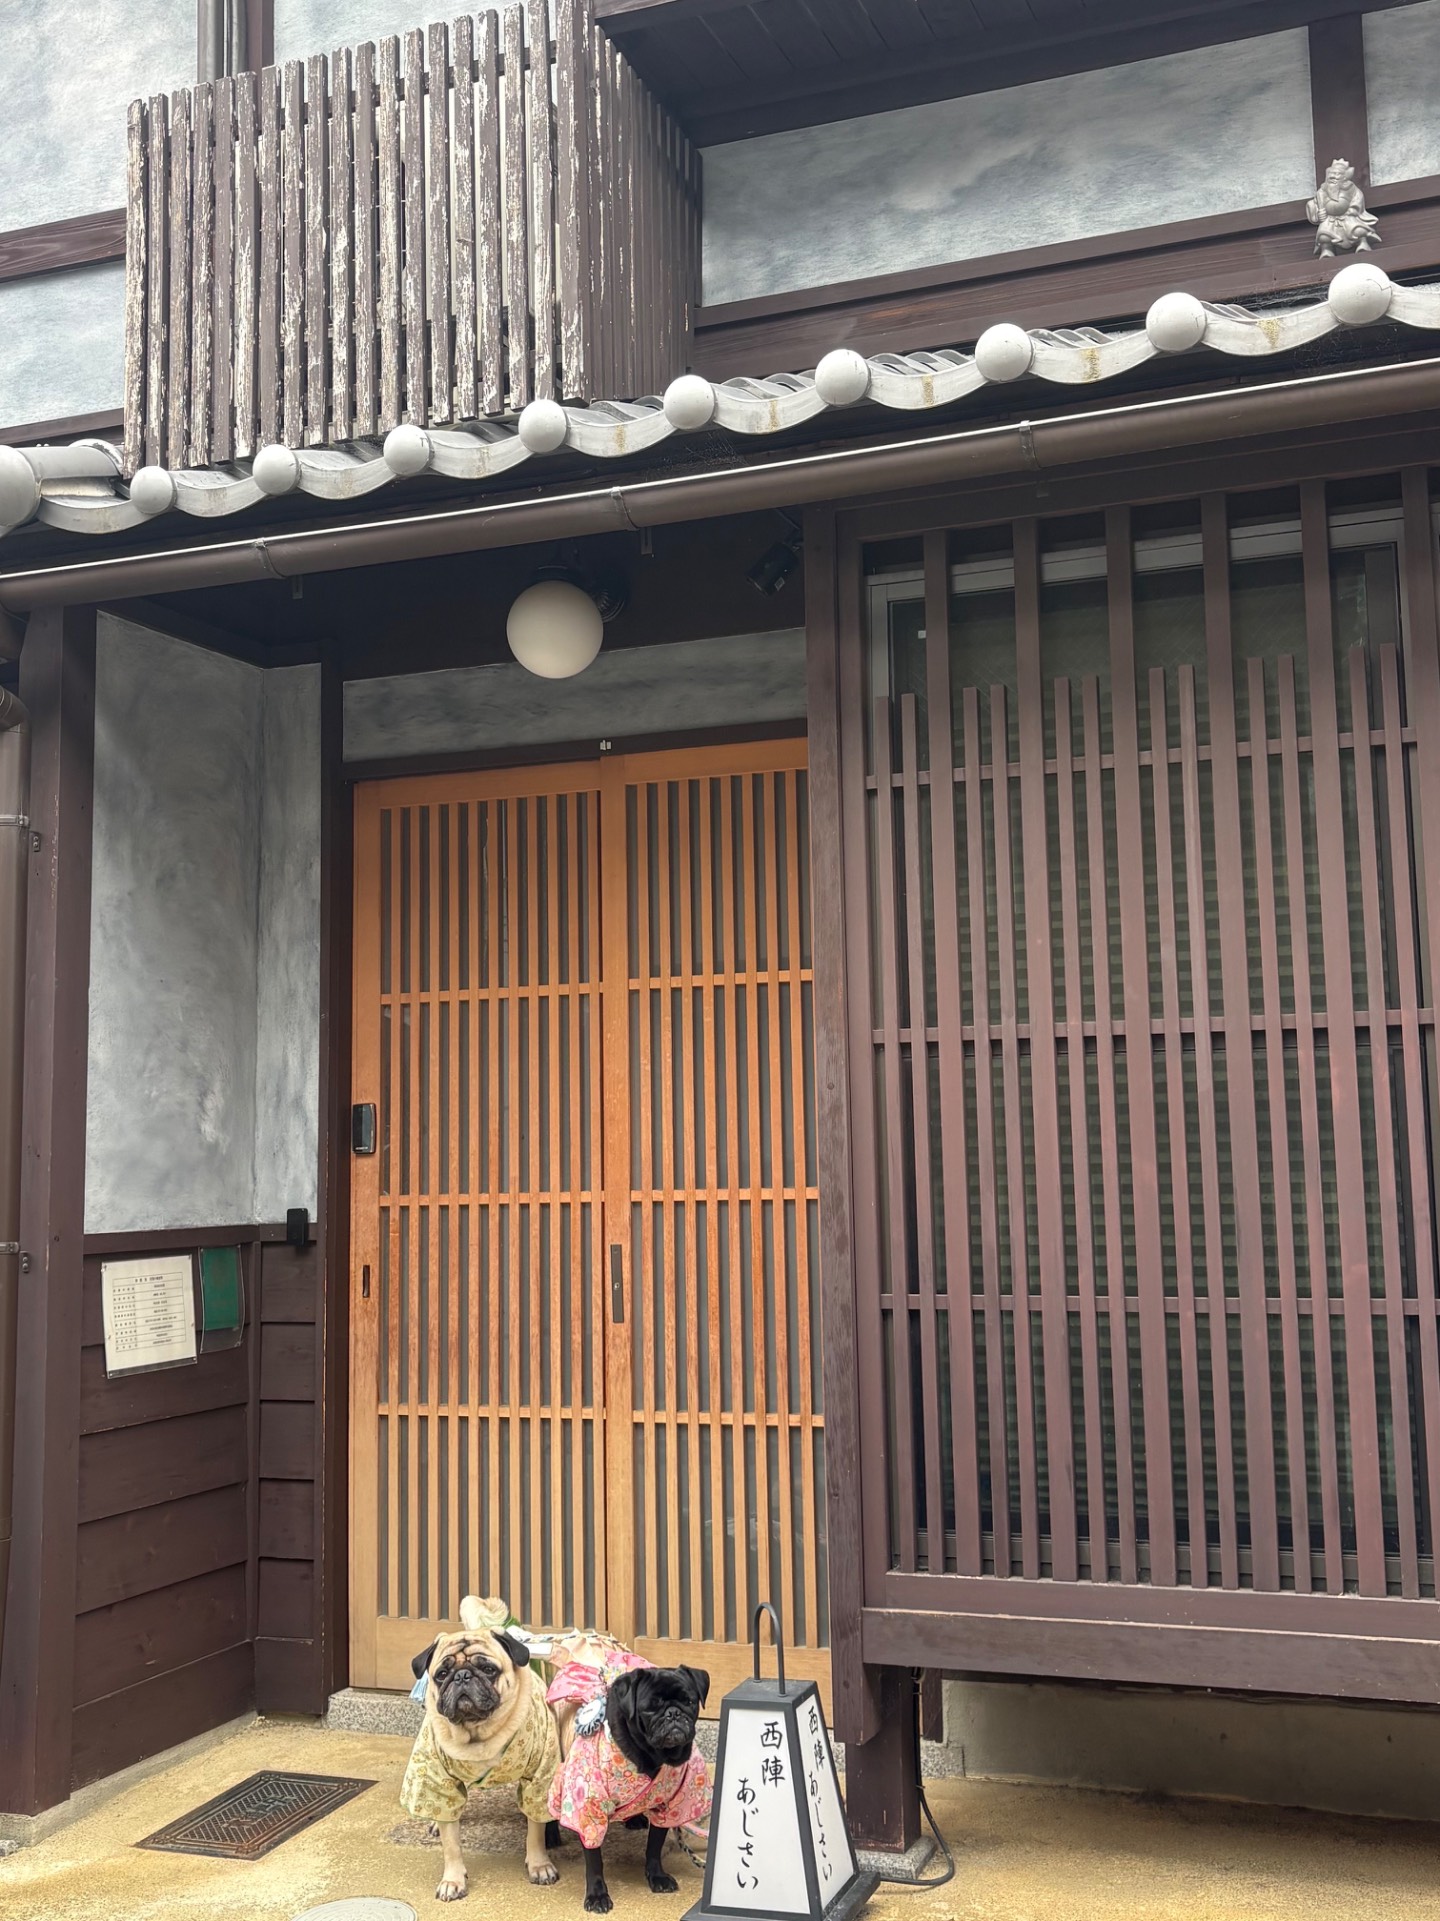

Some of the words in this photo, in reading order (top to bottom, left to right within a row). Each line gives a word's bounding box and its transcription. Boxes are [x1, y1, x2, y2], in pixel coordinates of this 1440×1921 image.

[760, 1721, 786, 1788] 西陣
[808, 1705, 825, 1771] 西陣
[736, 1777, 759, 1890] あじさい
[808, 1772, 833, 1881] あじさい
